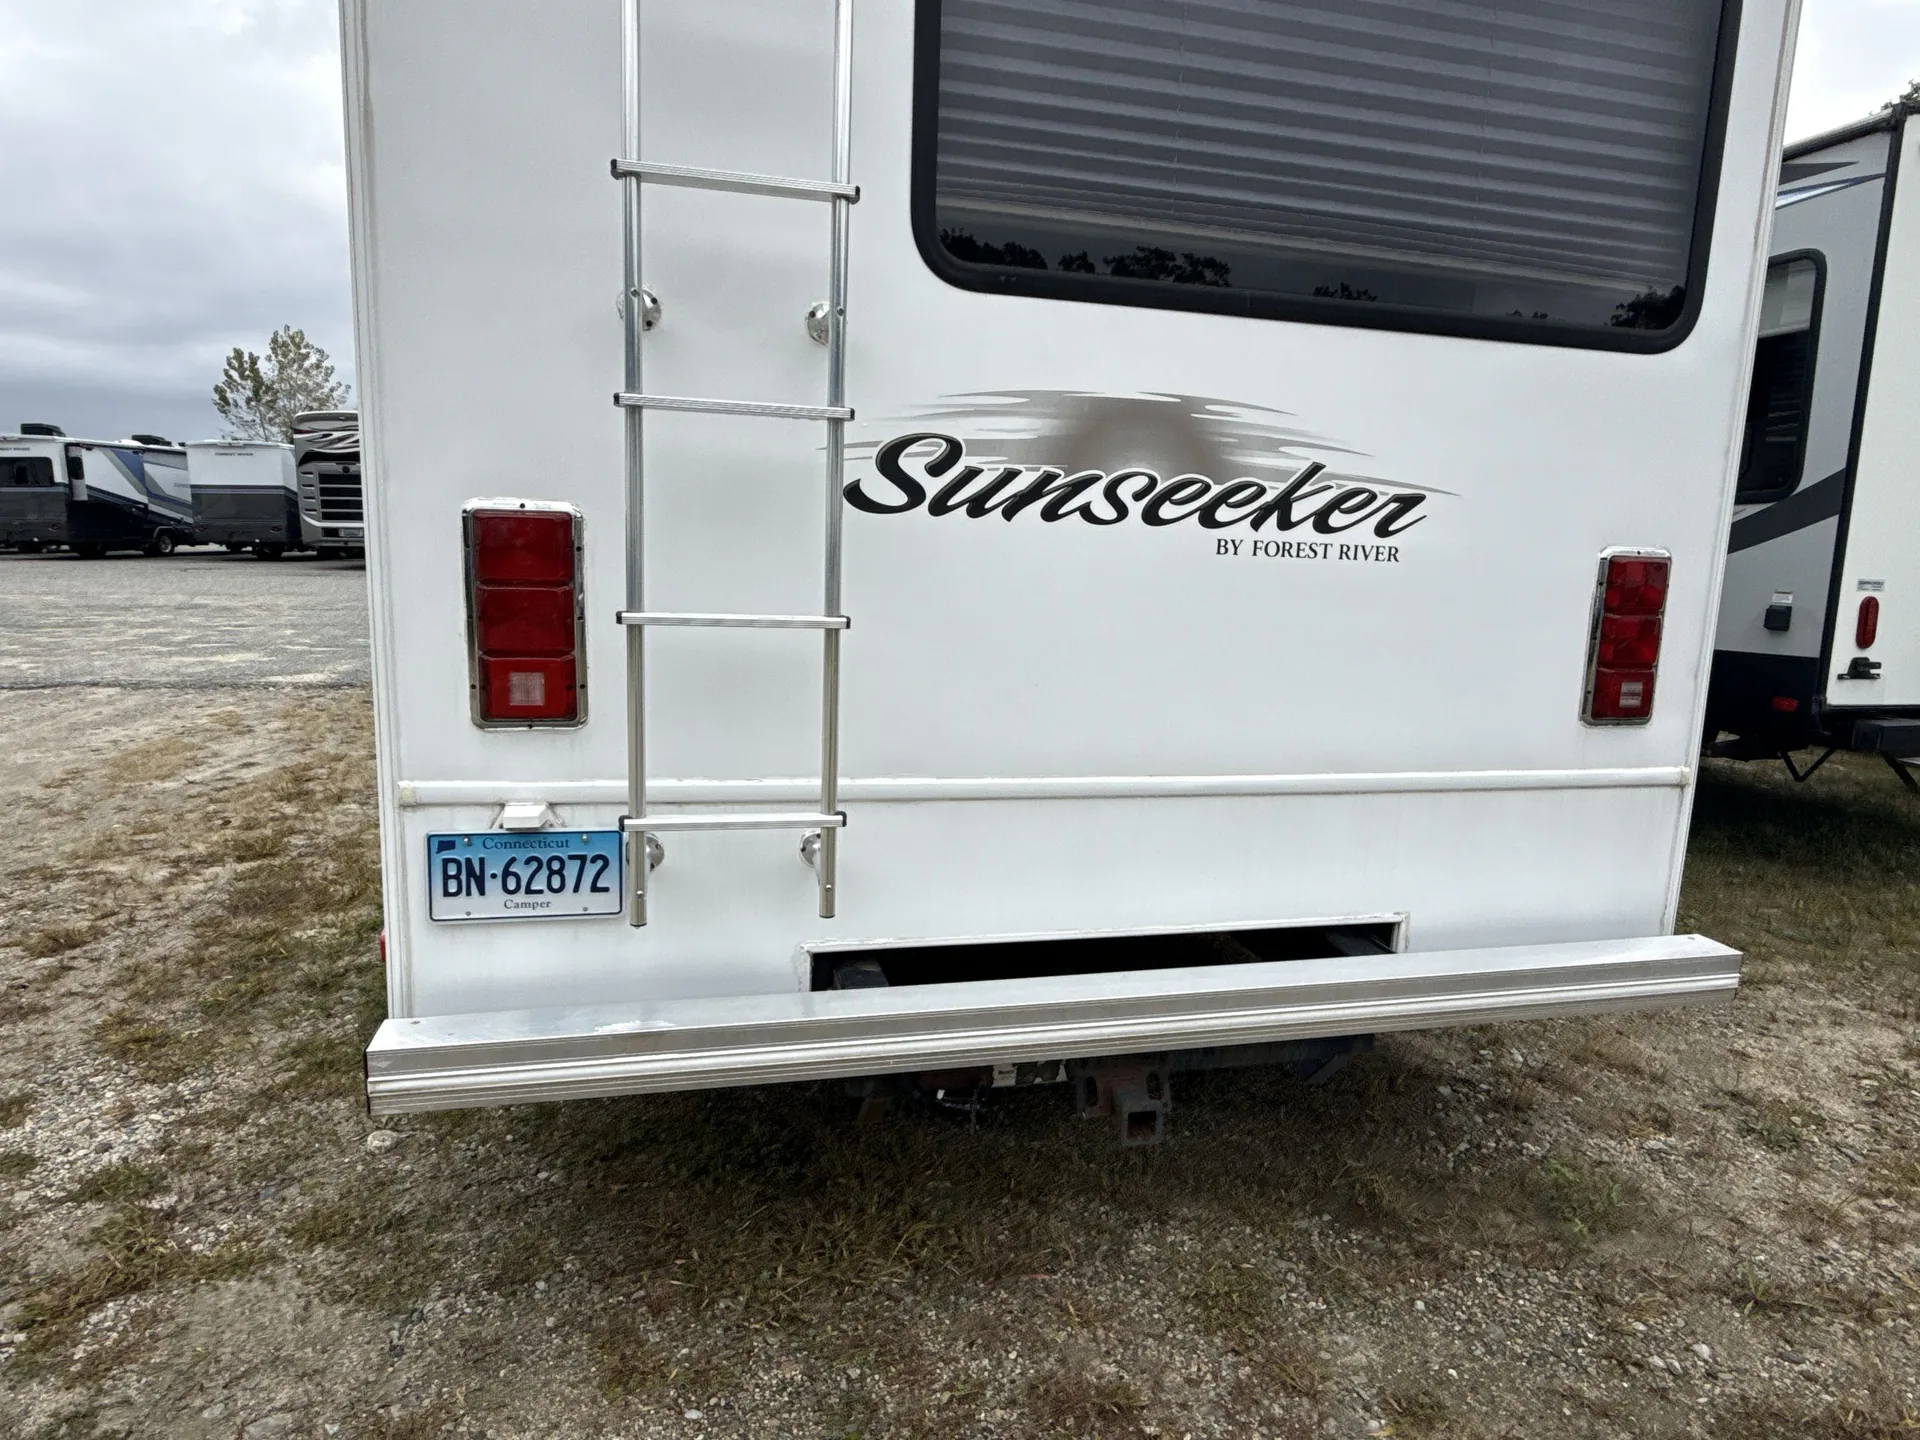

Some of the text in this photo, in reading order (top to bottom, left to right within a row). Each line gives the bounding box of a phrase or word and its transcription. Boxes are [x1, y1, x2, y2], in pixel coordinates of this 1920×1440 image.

[843, 432, 1428, 538] Sunseeker
[1215, 538, 1400, 562] BY FOREST RIVER
[482, 837, 570, 850] Connecticut
[503, 898, 552, 911] Camper
